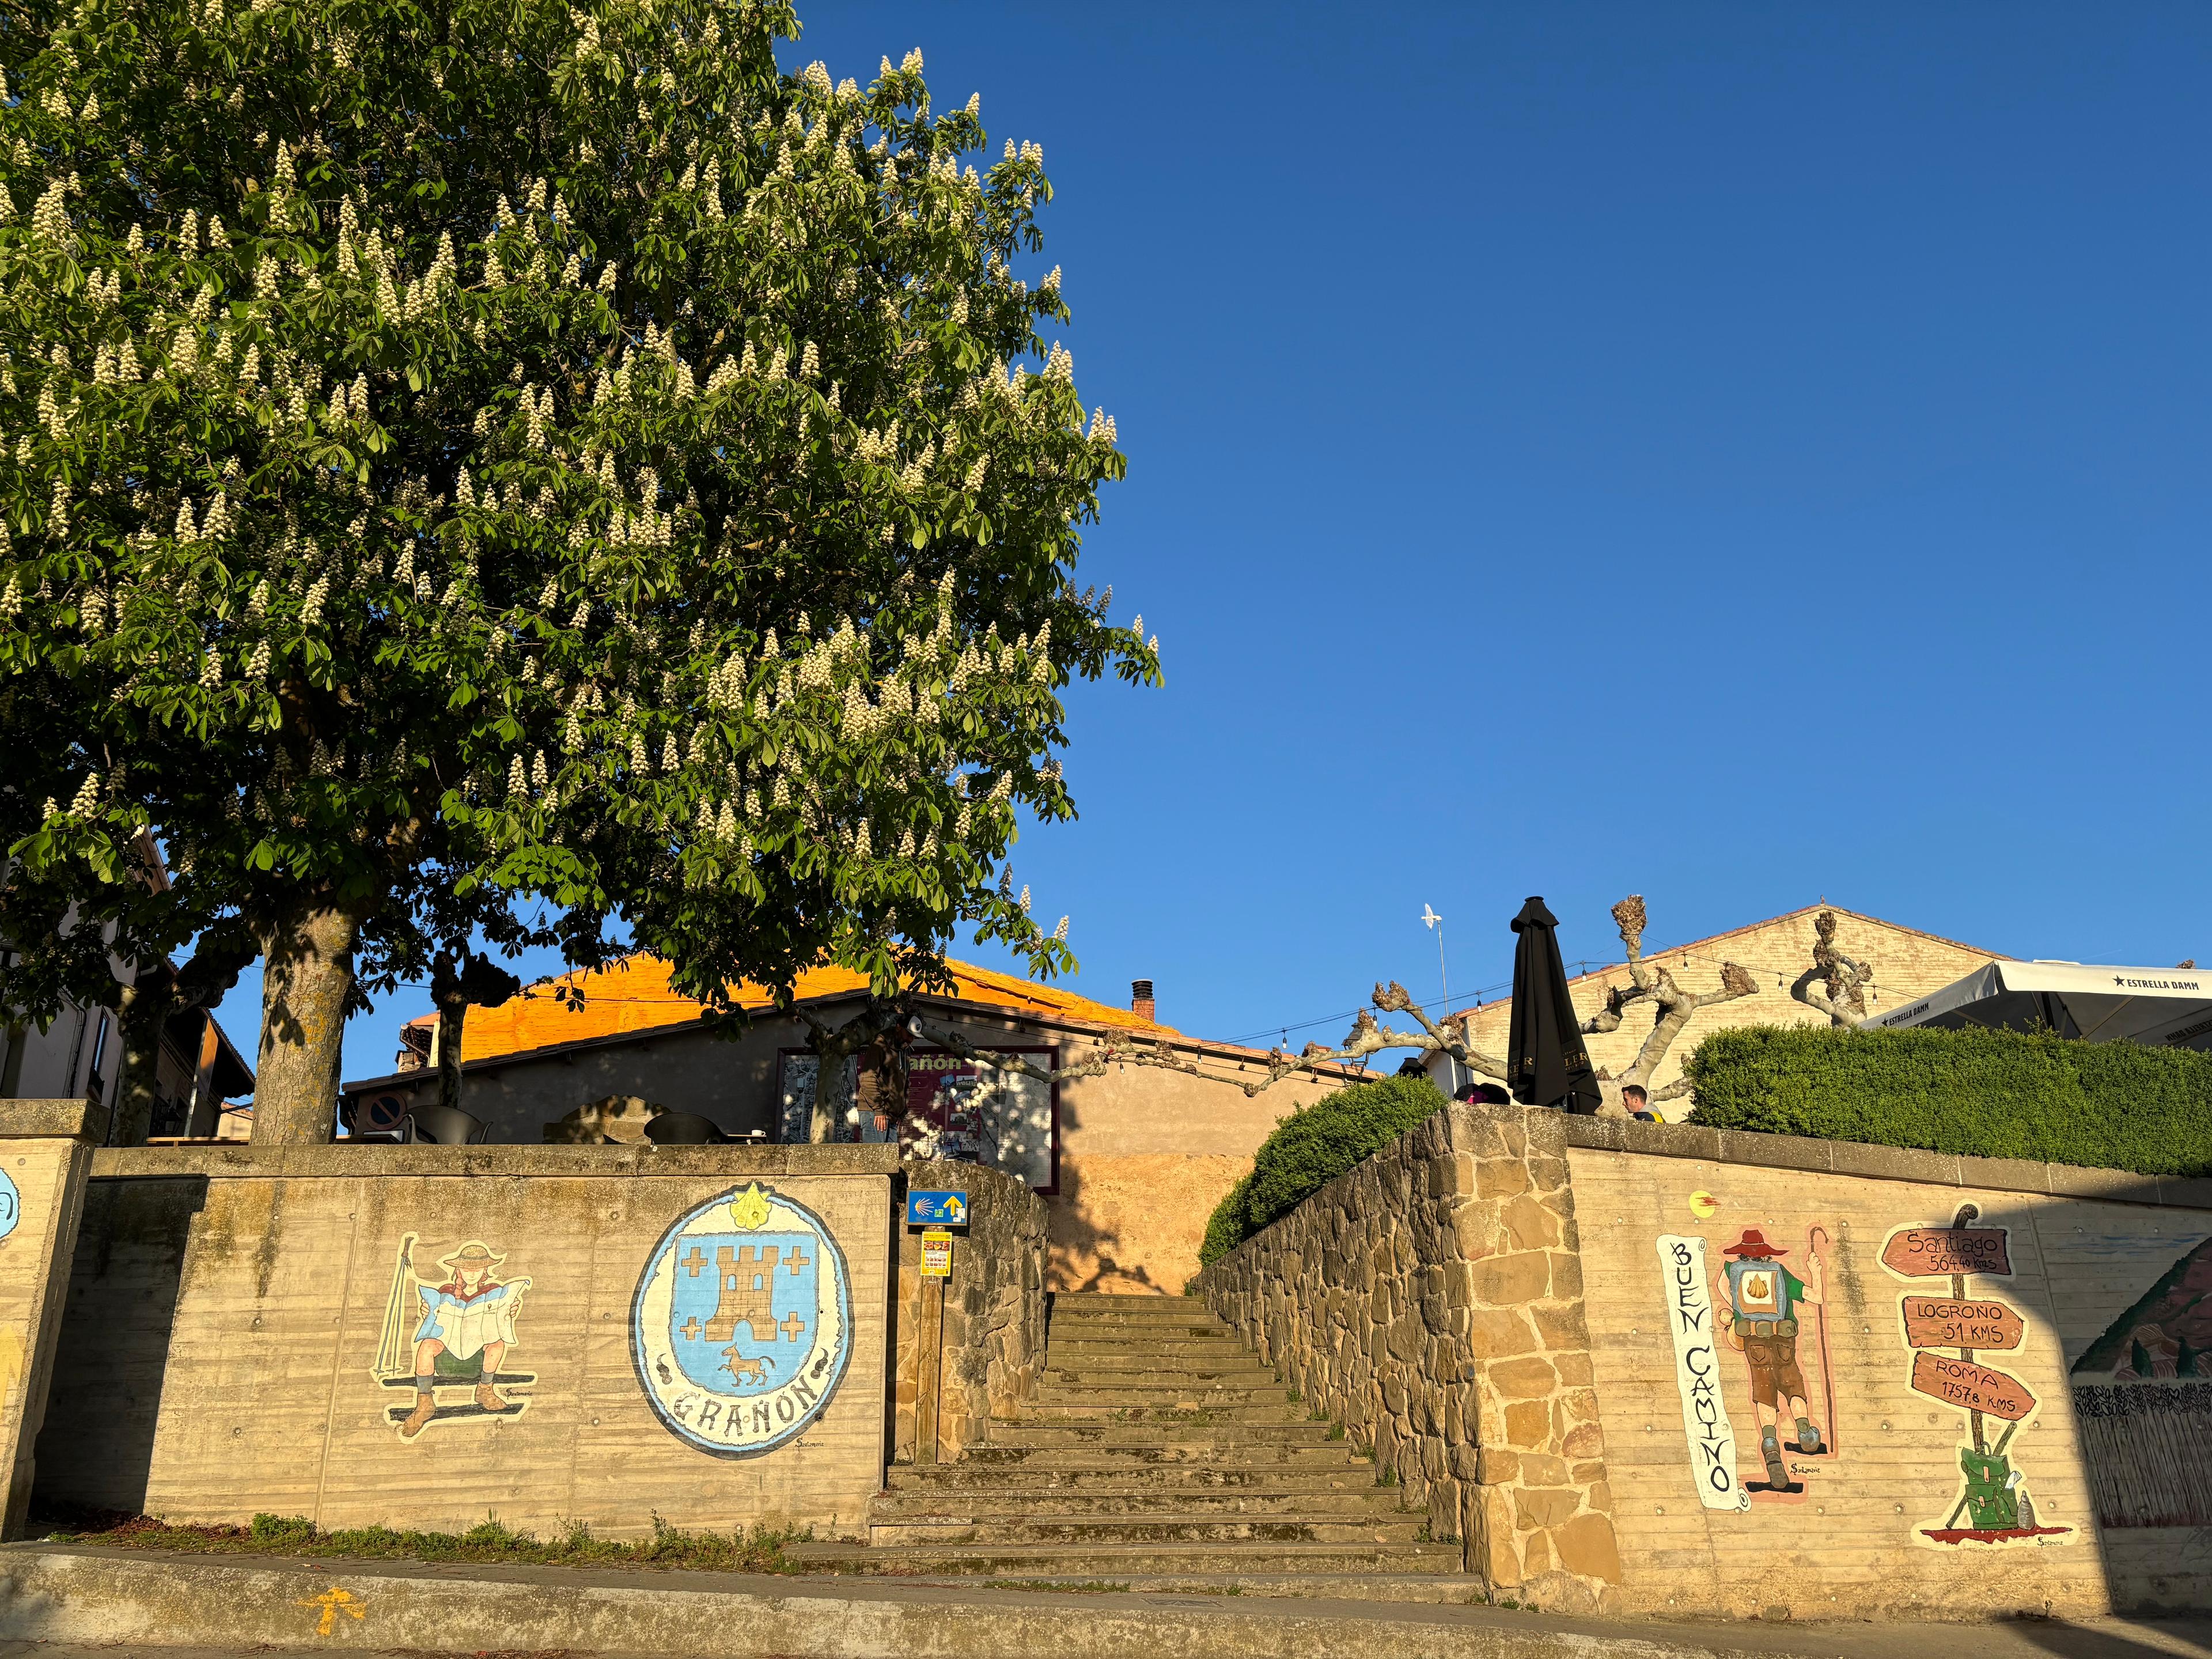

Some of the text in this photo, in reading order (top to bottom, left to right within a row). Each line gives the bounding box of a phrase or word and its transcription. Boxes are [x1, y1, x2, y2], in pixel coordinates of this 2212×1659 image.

[2127, 979, 2199, 990] ESTRELLA DAMM
[1889, 1002, 1929, 1026] ESTRELLA DAMM
[1907, 1231, 1998, 1257] Santiago
[1927, 1255, 1970, 1271] 564,40
[1670, 1242, 1709, 1334] BUEN
[1918, 1303, 2002, 1320] LOGROÑO
[1971, 1325, 2003, 1343] KMS
[1936, 1360, 1998, 1389] ROMA
[673, 1374, 817, 1437] GRAÑÓN
[1987, 1395, 2016, 1412] KMS
[1686, 1345, 1730, 1492] CAMINO
